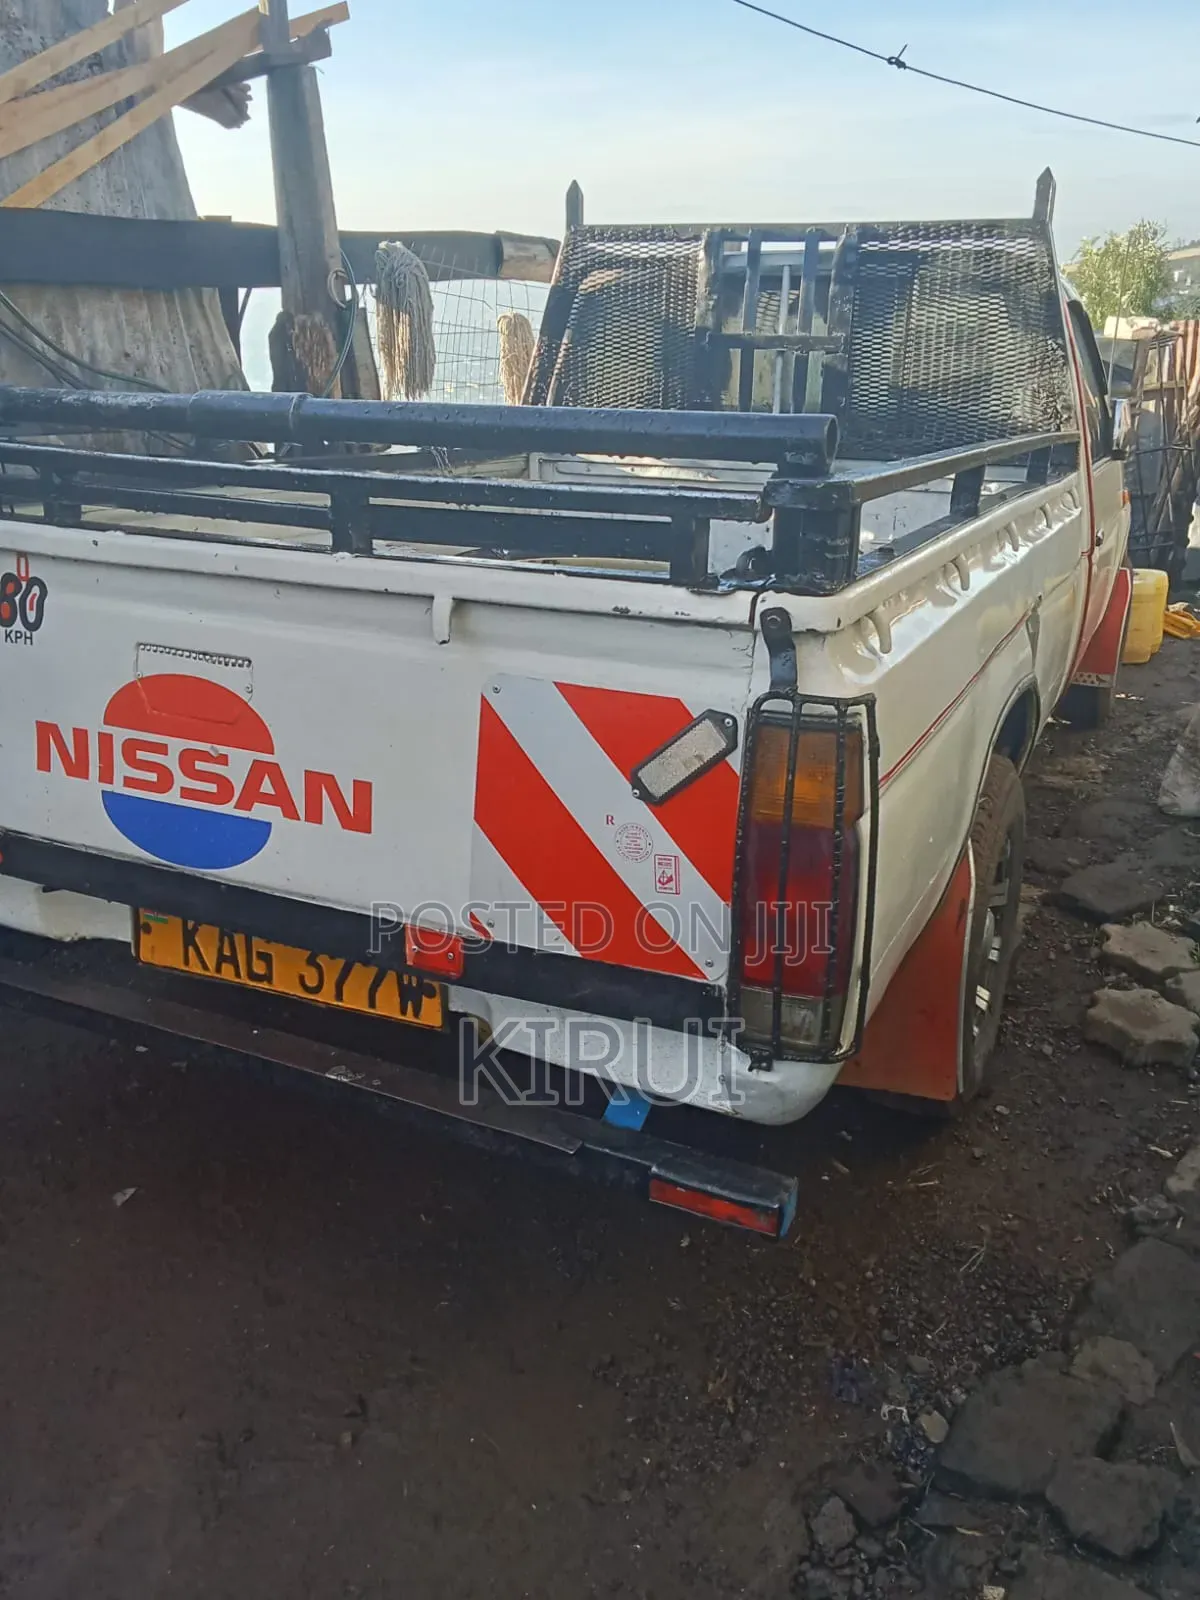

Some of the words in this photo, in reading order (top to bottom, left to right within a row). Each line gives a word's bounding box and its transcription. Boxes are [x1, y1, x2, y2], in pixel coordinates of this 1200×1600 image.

[0, 572, 48, 632] 80
[4, 629, 34, 646] KPH
[35, 719, 373, 834] NISSAN
[606, 815, 615, 825] R
[182, 919, 275, 985] KAG
